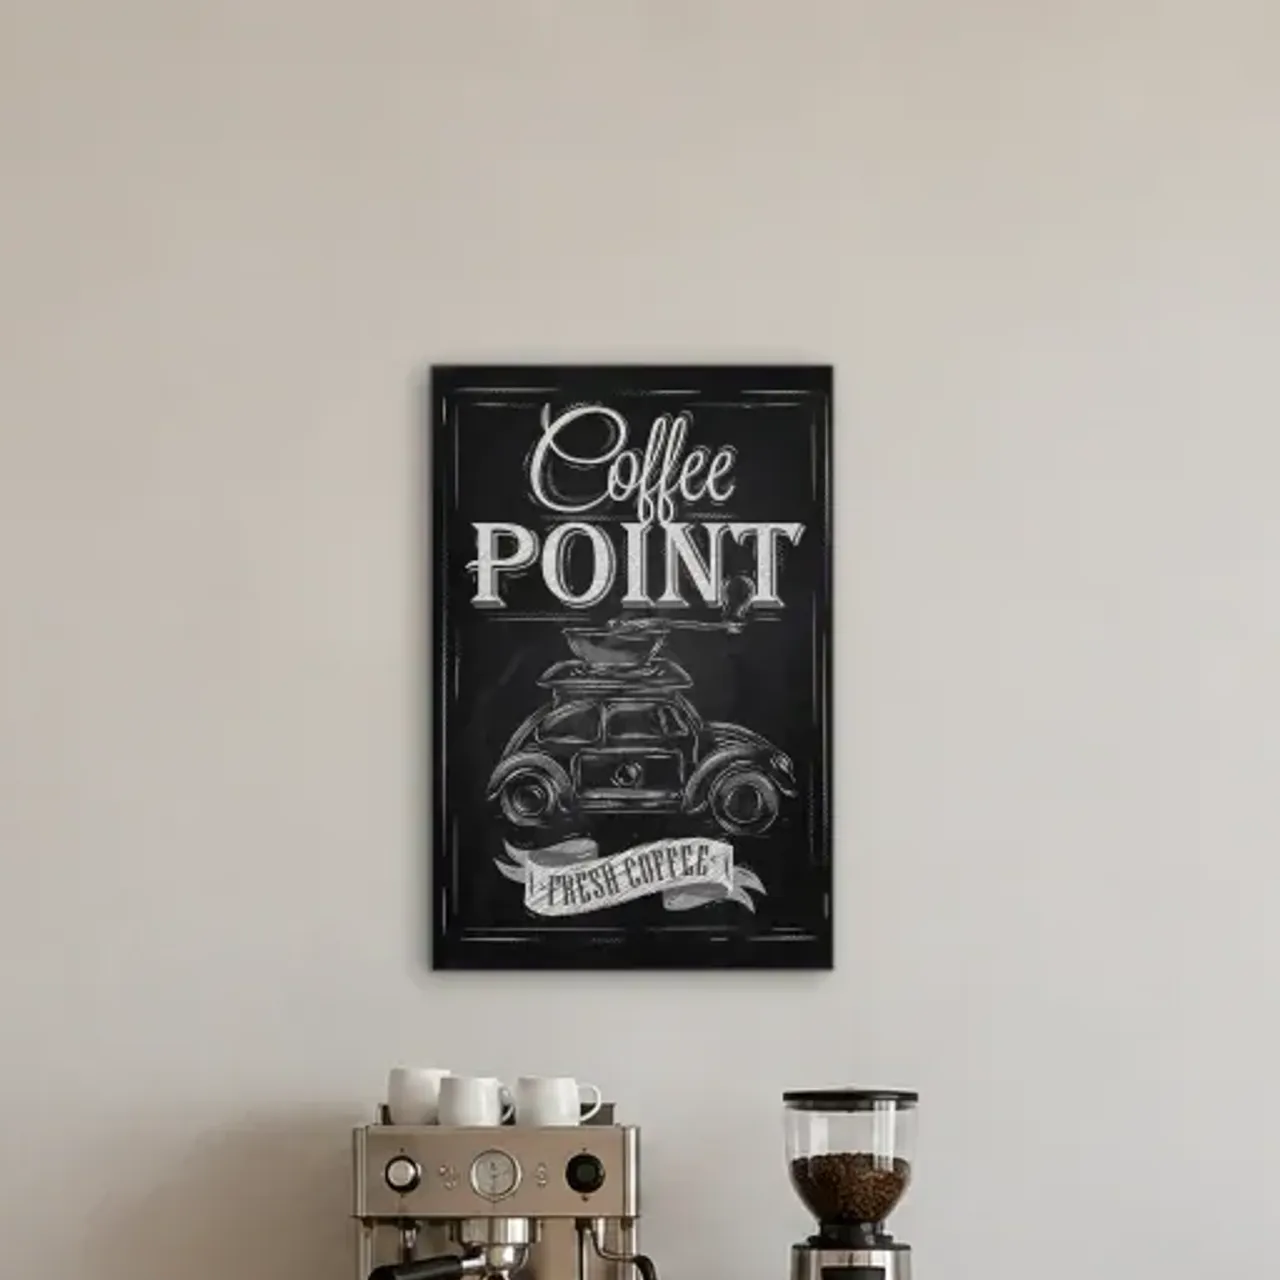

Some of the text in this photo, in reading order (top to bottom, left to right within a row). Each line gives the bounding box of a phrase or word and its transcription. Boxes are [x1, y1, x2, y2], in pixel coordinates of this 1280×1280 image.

[529, 402, 737, 521] Coffee
[465, 521, 806, 608] POINT
[547, 843, 710, 906] FRESH COFFEE
